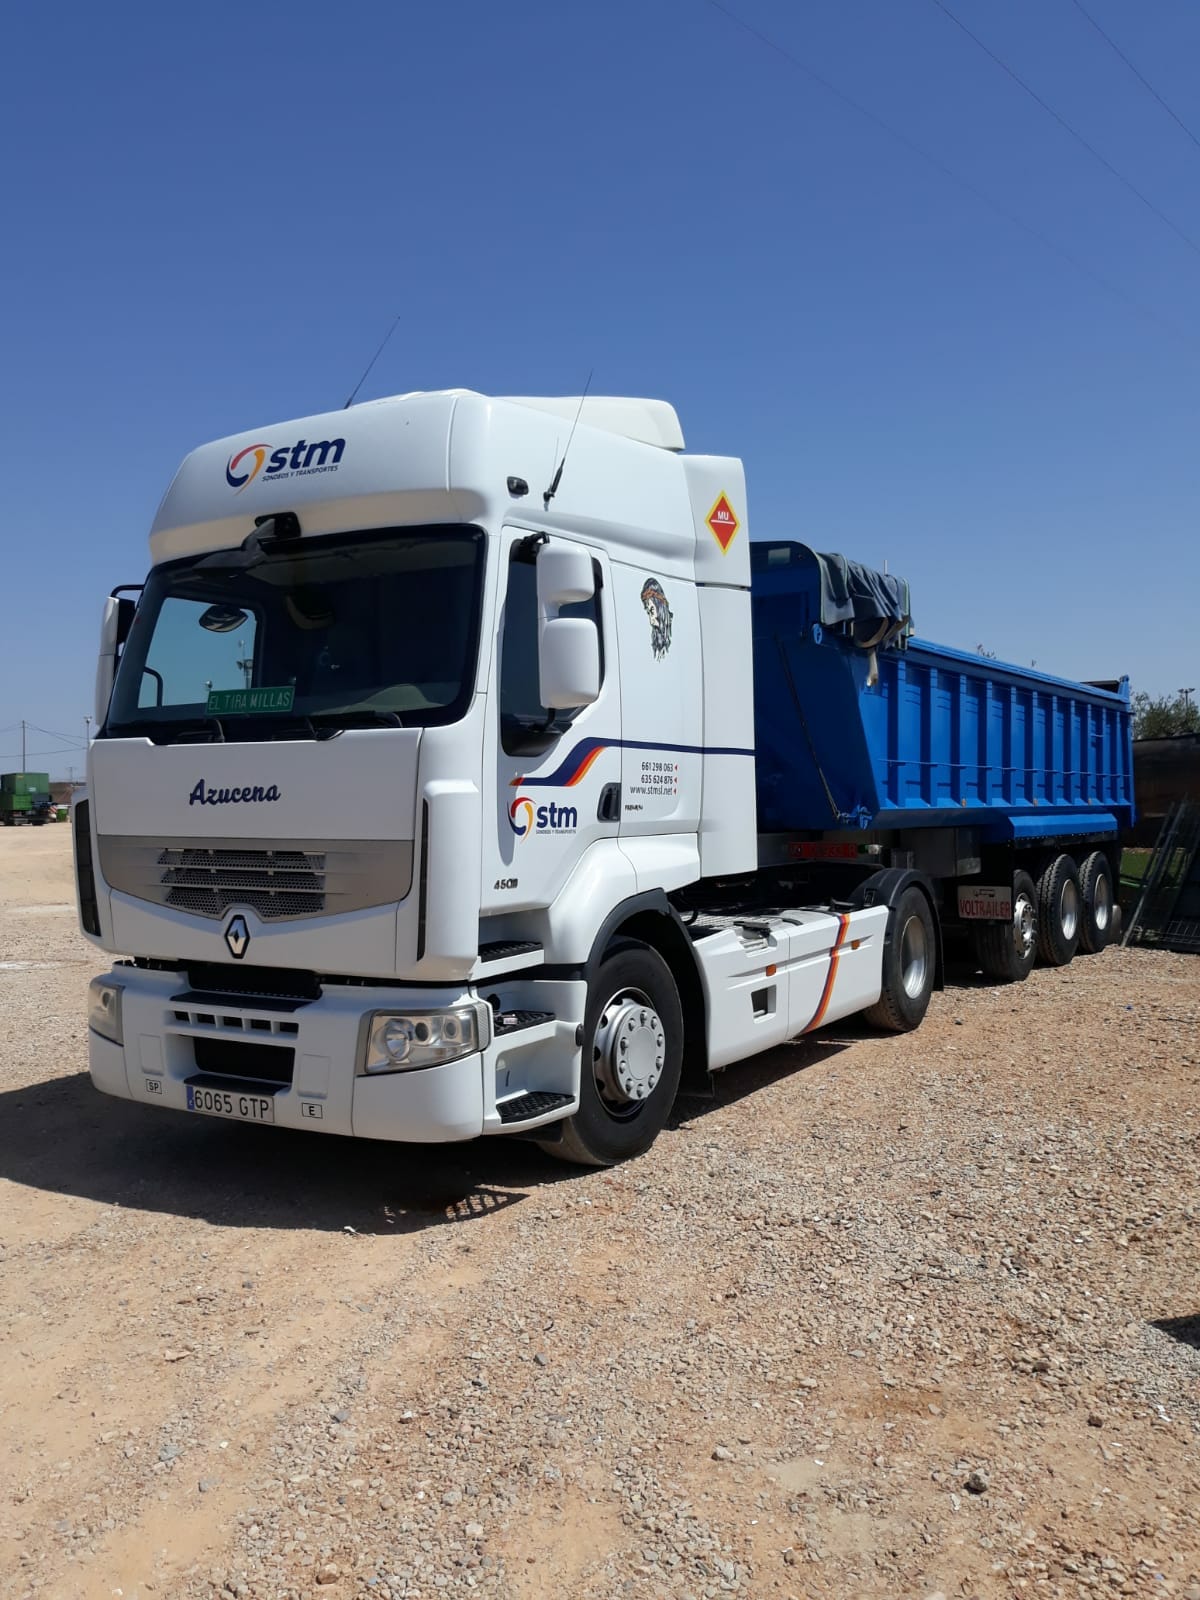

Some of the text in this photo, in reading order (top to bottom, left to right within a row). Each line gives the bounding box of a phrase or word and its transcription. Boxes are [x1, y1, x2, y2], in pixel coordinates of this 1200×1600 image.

[265, 438, 346, 474] stm
[261, 472, 290, 482] SONDEOS
[295, 464, 338, 477] TRANSPORTES
[717, 511, 729, 520] MU
[208, 692, 291, 710] EL TIRA MILLAS
[641, 761, 674, 773] 661 298 063
[640, 774, 652, 784] 635
[652, 775, 663, 784] 624
[189, 778, 281, 806] Azucena
[629, 785, 673, 796] www.stmsl.net
[536, 802, 577, 828] stm
[959, 899, 1012, 919] VOLTRAILER
[149, 1082, 159, 1092] SP
[194, 1090, 269, 1119] 6065 GTP
[308, 1106, 316, 1116] E
